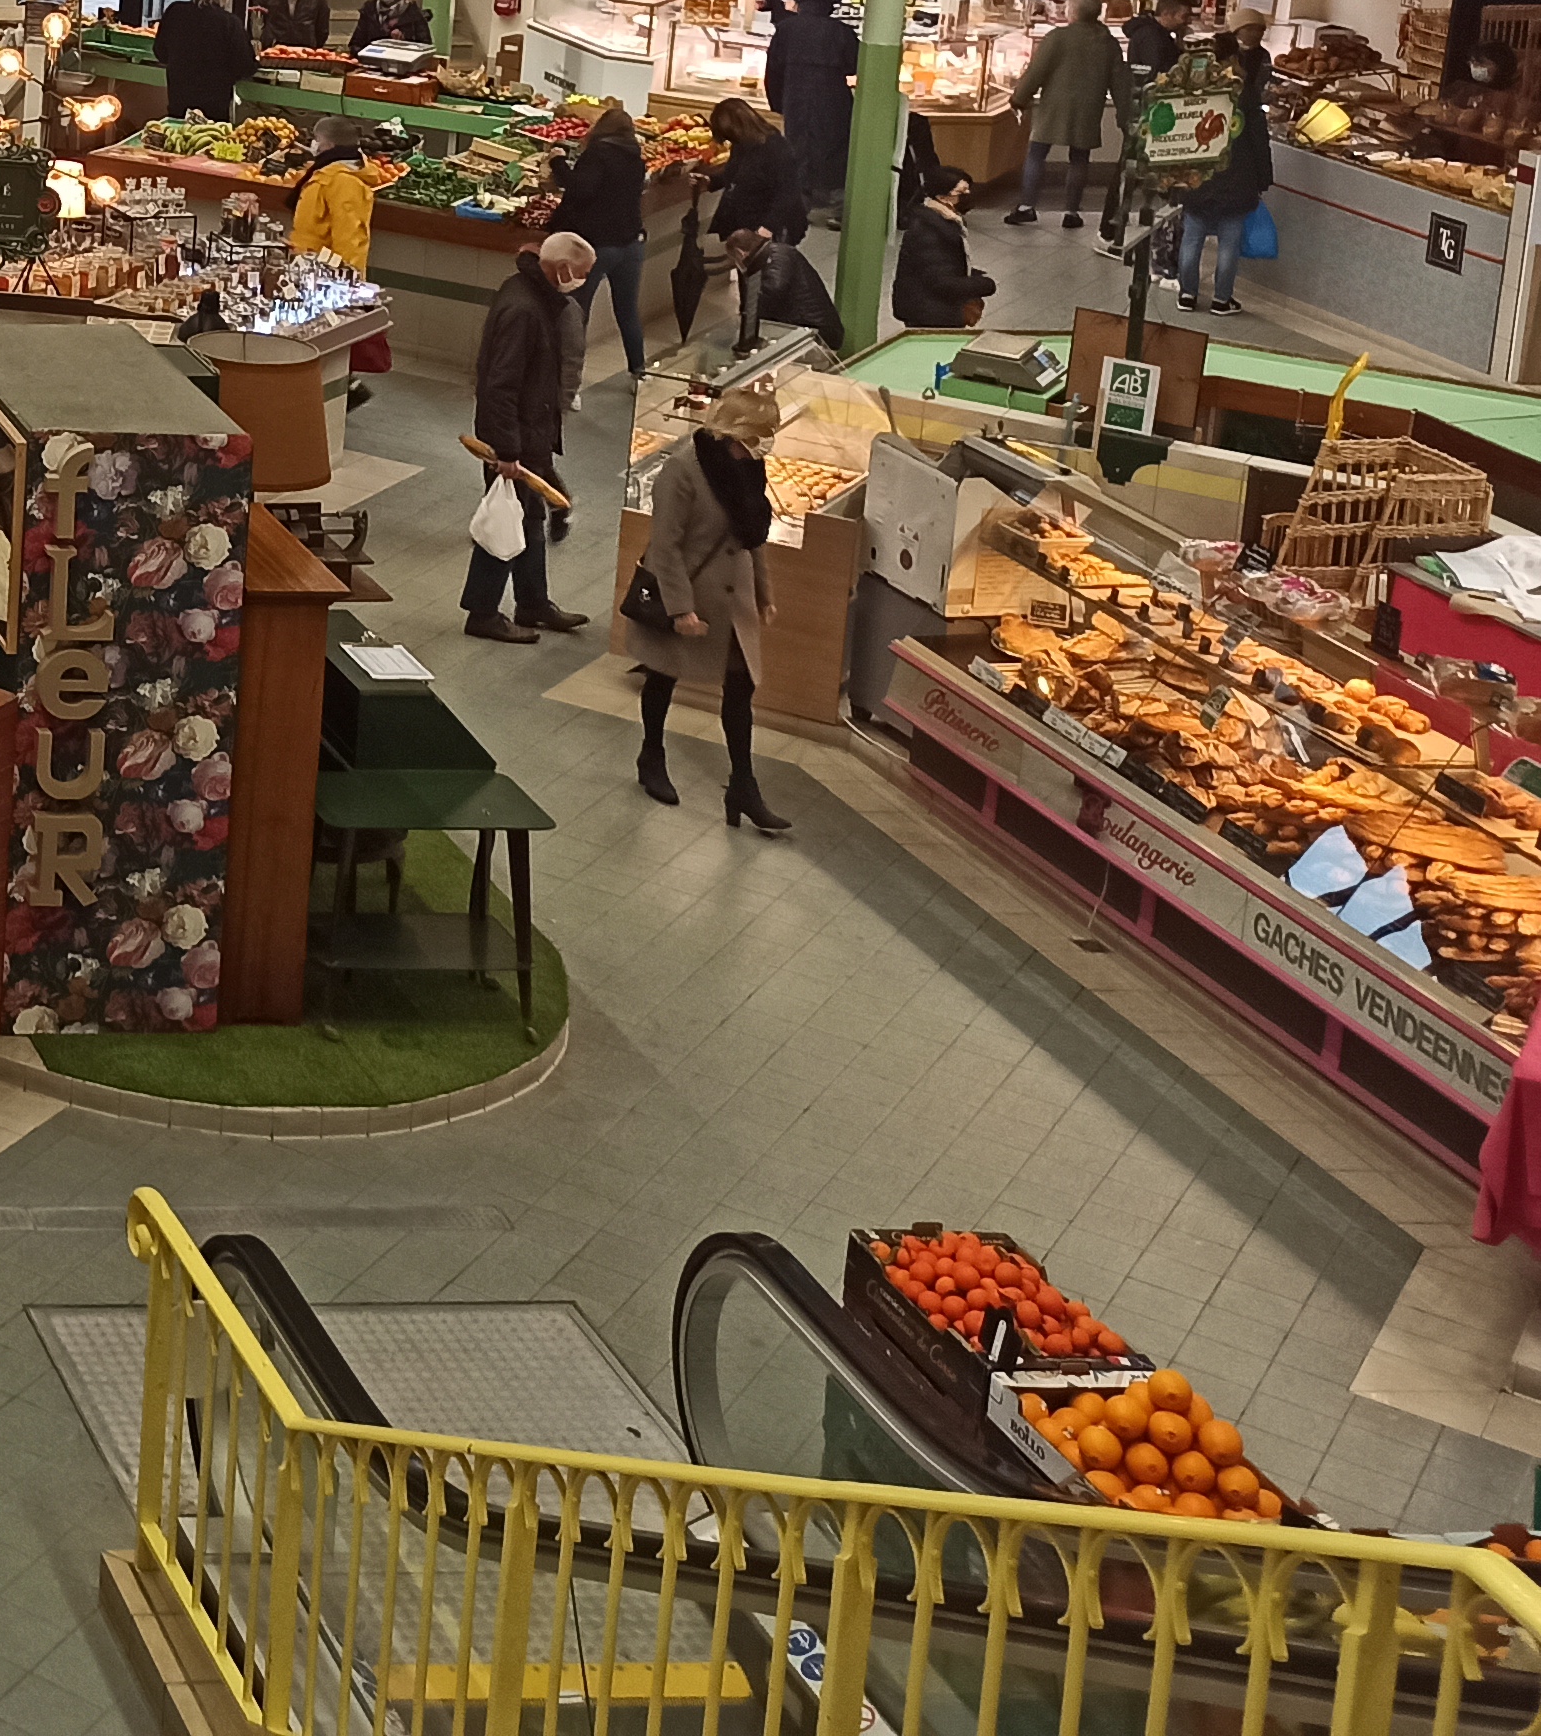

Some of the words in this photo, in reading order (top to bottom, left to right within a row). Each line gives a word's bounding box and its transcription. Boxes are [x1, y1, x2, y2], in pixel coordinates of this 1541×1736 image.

[1438, 226, 1456, 262] TG
[1112, 374, 1143, 395] AB
[917, 688, 1001, 752] Pâtisserie
[1101, 816, 1197, 888] oulangerie
[1253, 912, 1345, 997] GACHES
